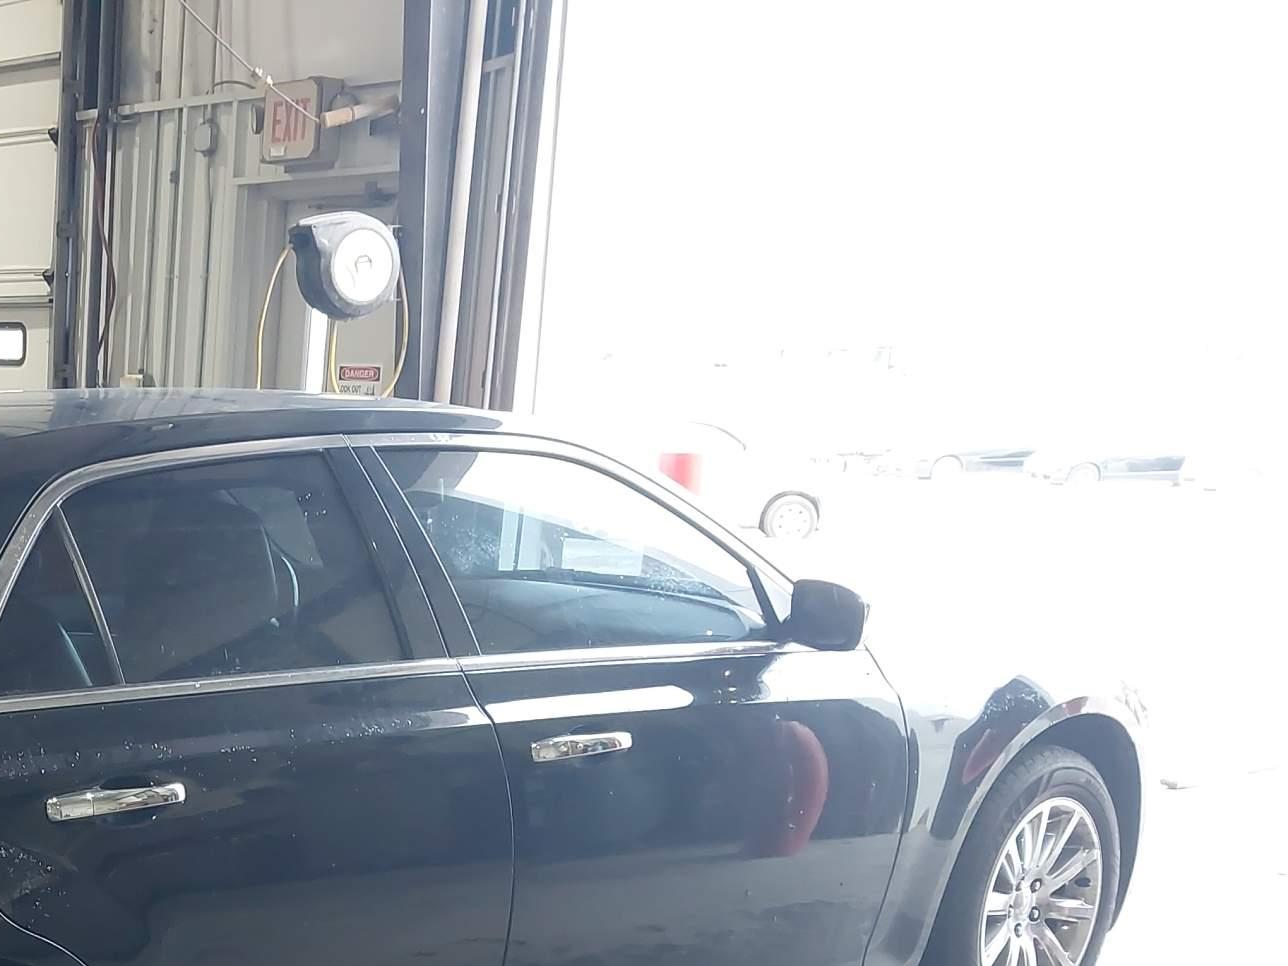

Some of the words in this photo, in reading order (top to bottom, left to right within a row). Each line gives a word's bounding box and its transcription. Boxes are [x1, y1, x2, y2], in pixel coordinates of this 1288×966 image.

[271, 97, 311, 142] EXIT
[344, 369, 375, 378] DANGER
[352, 384, 361, 393] OUT
